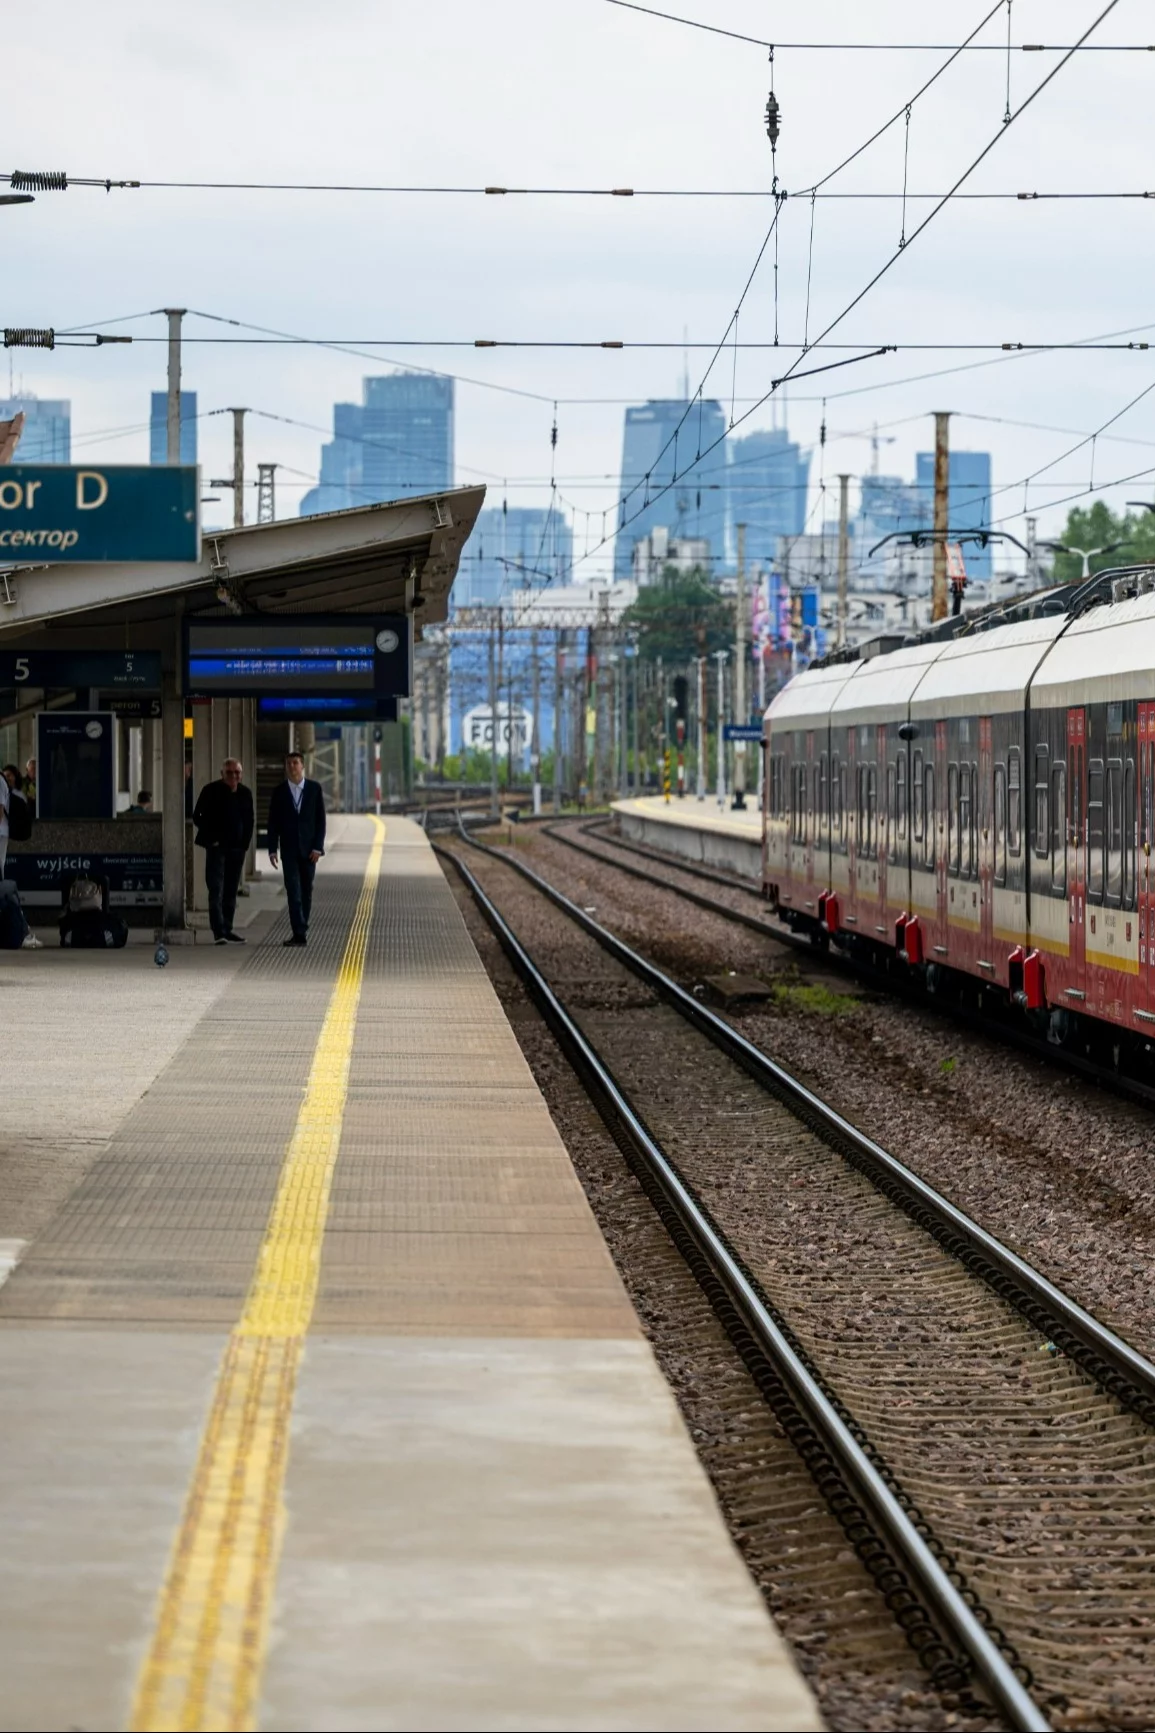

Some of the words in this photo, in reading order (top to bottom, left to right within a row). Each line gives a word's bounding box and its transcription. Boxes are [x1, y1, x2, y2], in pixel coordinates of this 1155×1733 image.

[76, 471, 109, 510] D
[0, 529, 79, 551] сектор
[14, 658, 30, 681] 5
[126, 661, 133, 673] 5
[150, 700, 161, 716] 5
[37, 857, 91, 872] wyjście
